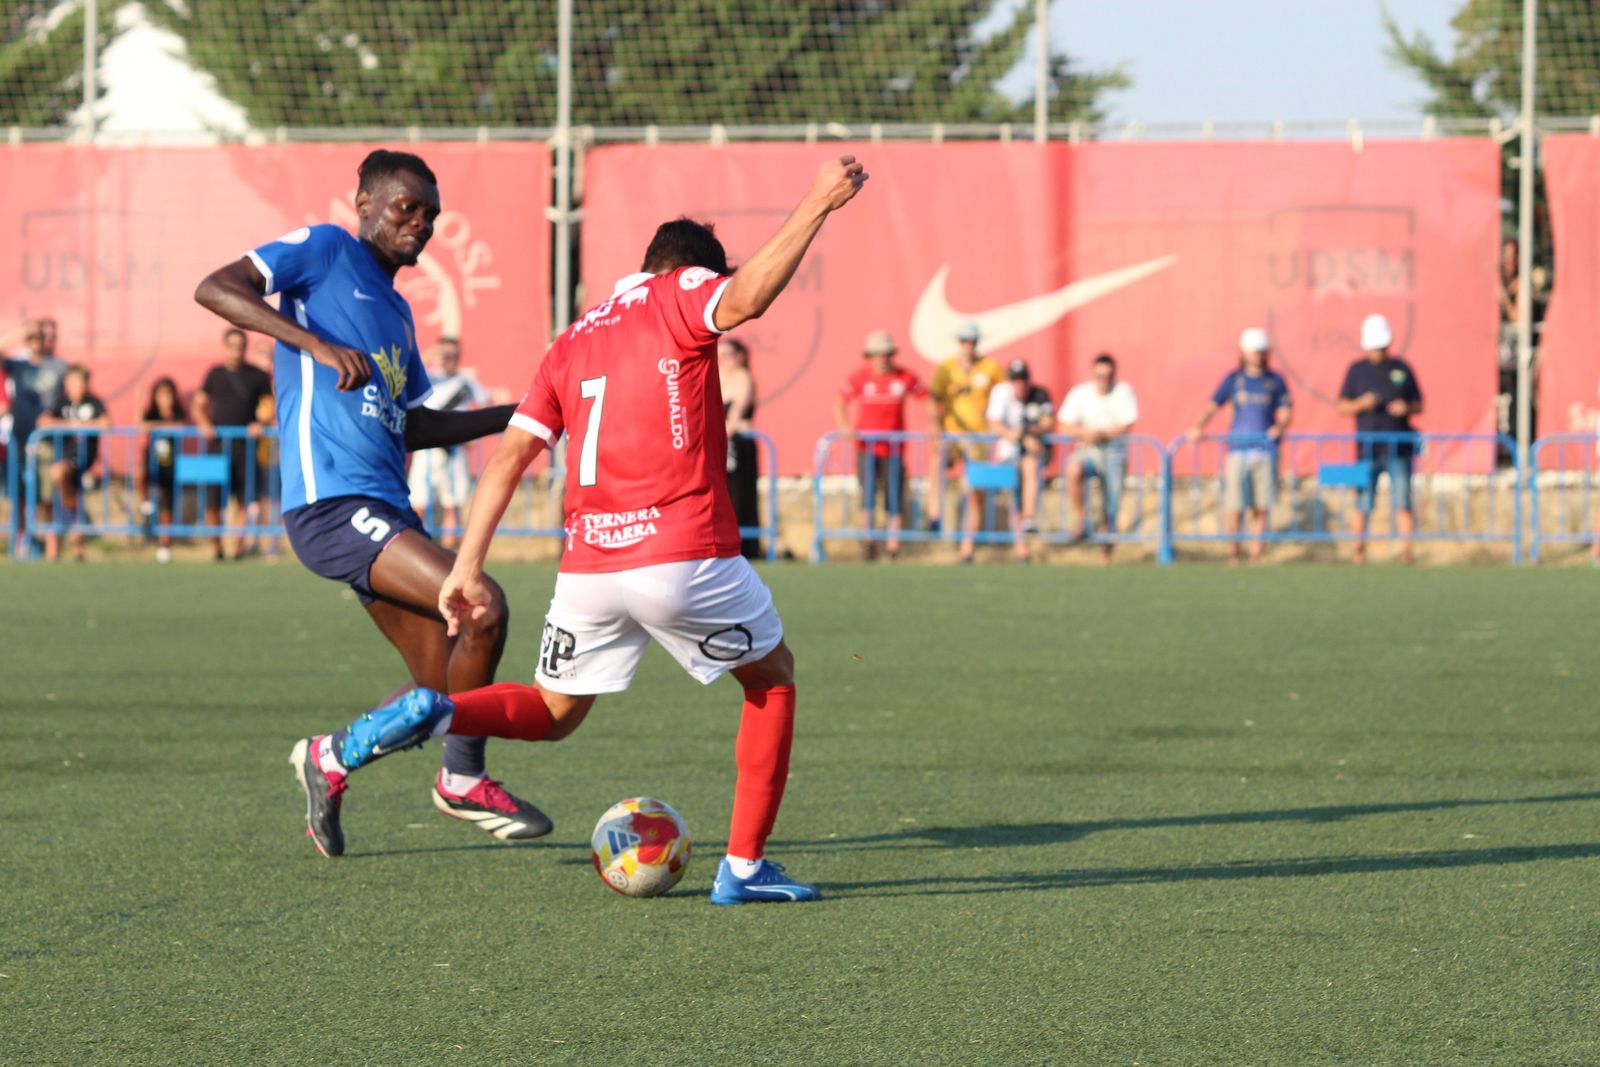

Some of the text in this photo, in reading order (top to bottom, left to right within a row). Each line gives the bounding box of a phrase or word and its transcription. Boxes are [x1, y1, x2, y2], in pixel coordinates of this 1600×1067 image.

[20, 251, 164, 291] UDSM
[1267, 247, 1415, 289] UDSM
[658, 357, 684, 450] GUINALDO
[578, 375, 607, 488] 7
[350, 506, 391, 542] 5
[580, 505, 661, 529] TERNERA
[584, 521, 657, 544] CHARRA
